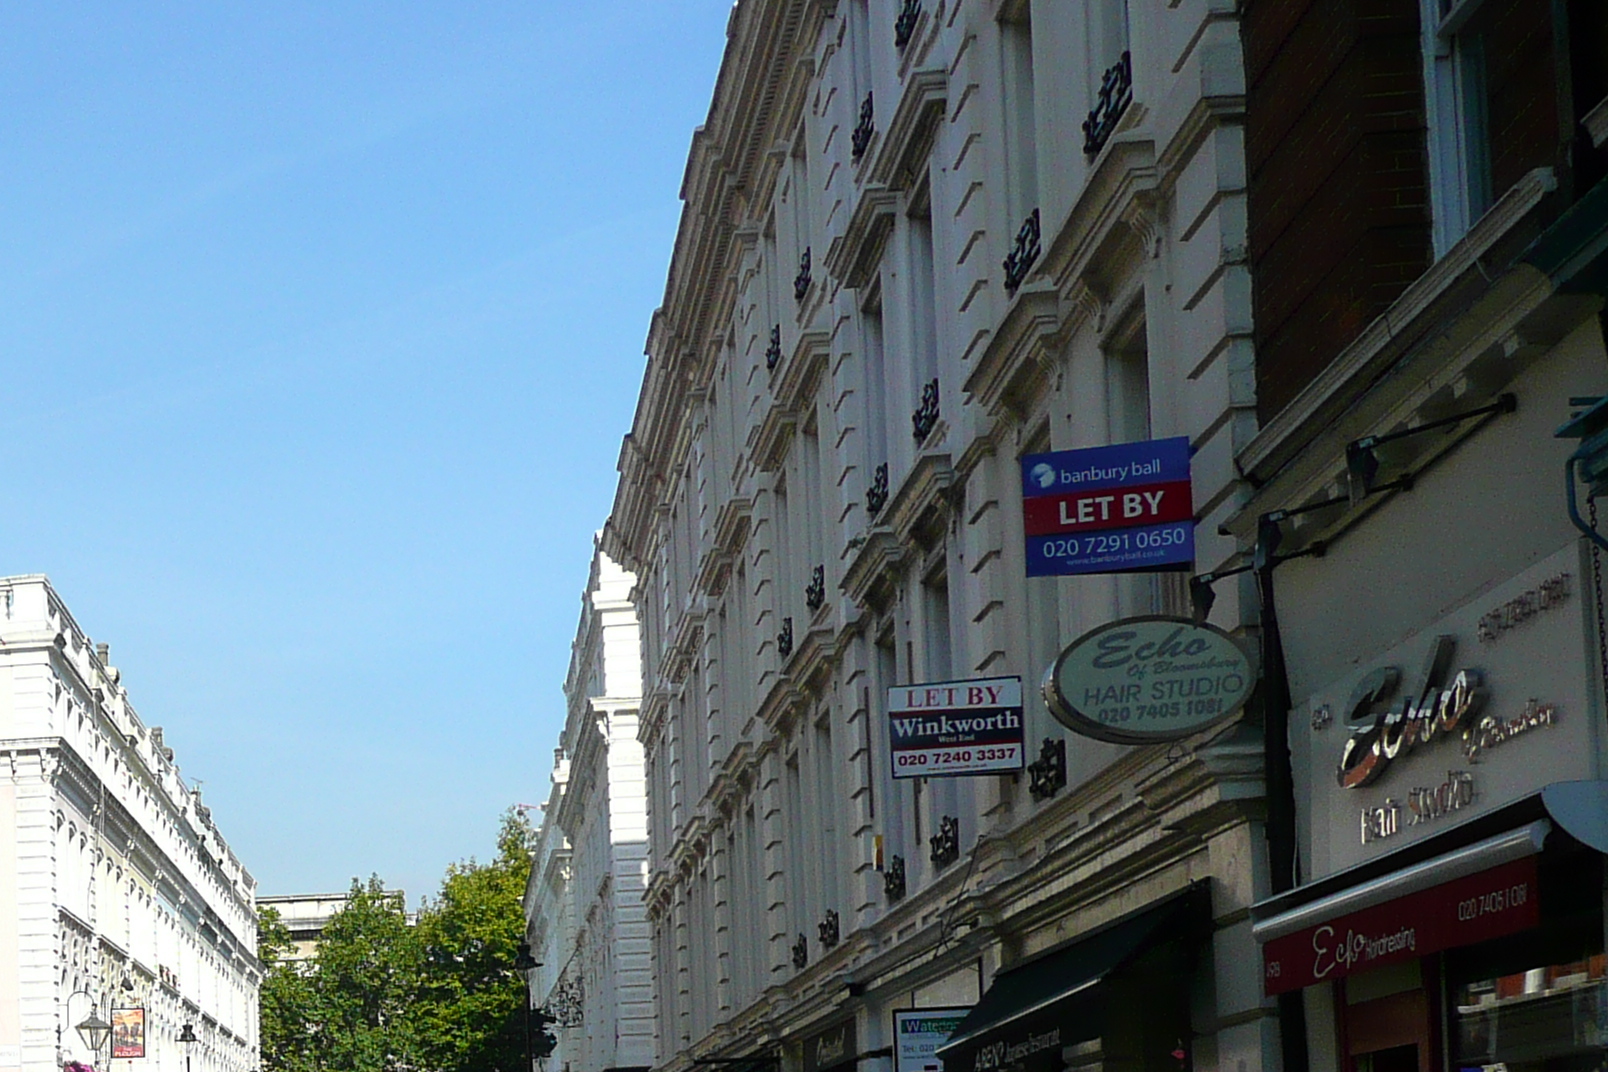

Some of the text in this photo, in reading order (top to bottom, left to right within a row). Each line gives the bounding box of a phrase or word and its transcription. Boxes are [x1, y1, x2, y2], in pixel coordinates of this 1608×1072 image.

[1060, 458, 1160, 484] banbury ball
[1059, 490, 1165, 525] LET BY
[1043, 528, 1185, 558] 020 7291 0650
[1092, 626, 1212, 669] Echo
[1126, 656, 1241, 681] Of Bloomsbury
[906, 685, 1004, 708] LET BY
[1083, 673, 1244, 708] HAIR STUDIO
[892, 709, 1020, 738] Winkworth
[1098, 697, 1223, 724] 020 7405 1081
[1337, 633, 1486, 789] Echo
[938, 733, 975, 743] West End
[898, 747, 1016, 766] 020 7240 3337
[1360, 797, 1400, 845] Hair
[1312, 925, 1365, 979] Echo
[1365, 925, 1416, 961] Hairdressing
[1457, 900, 1476, 922] 020
[1478, 890, 1503, 916] 7405
